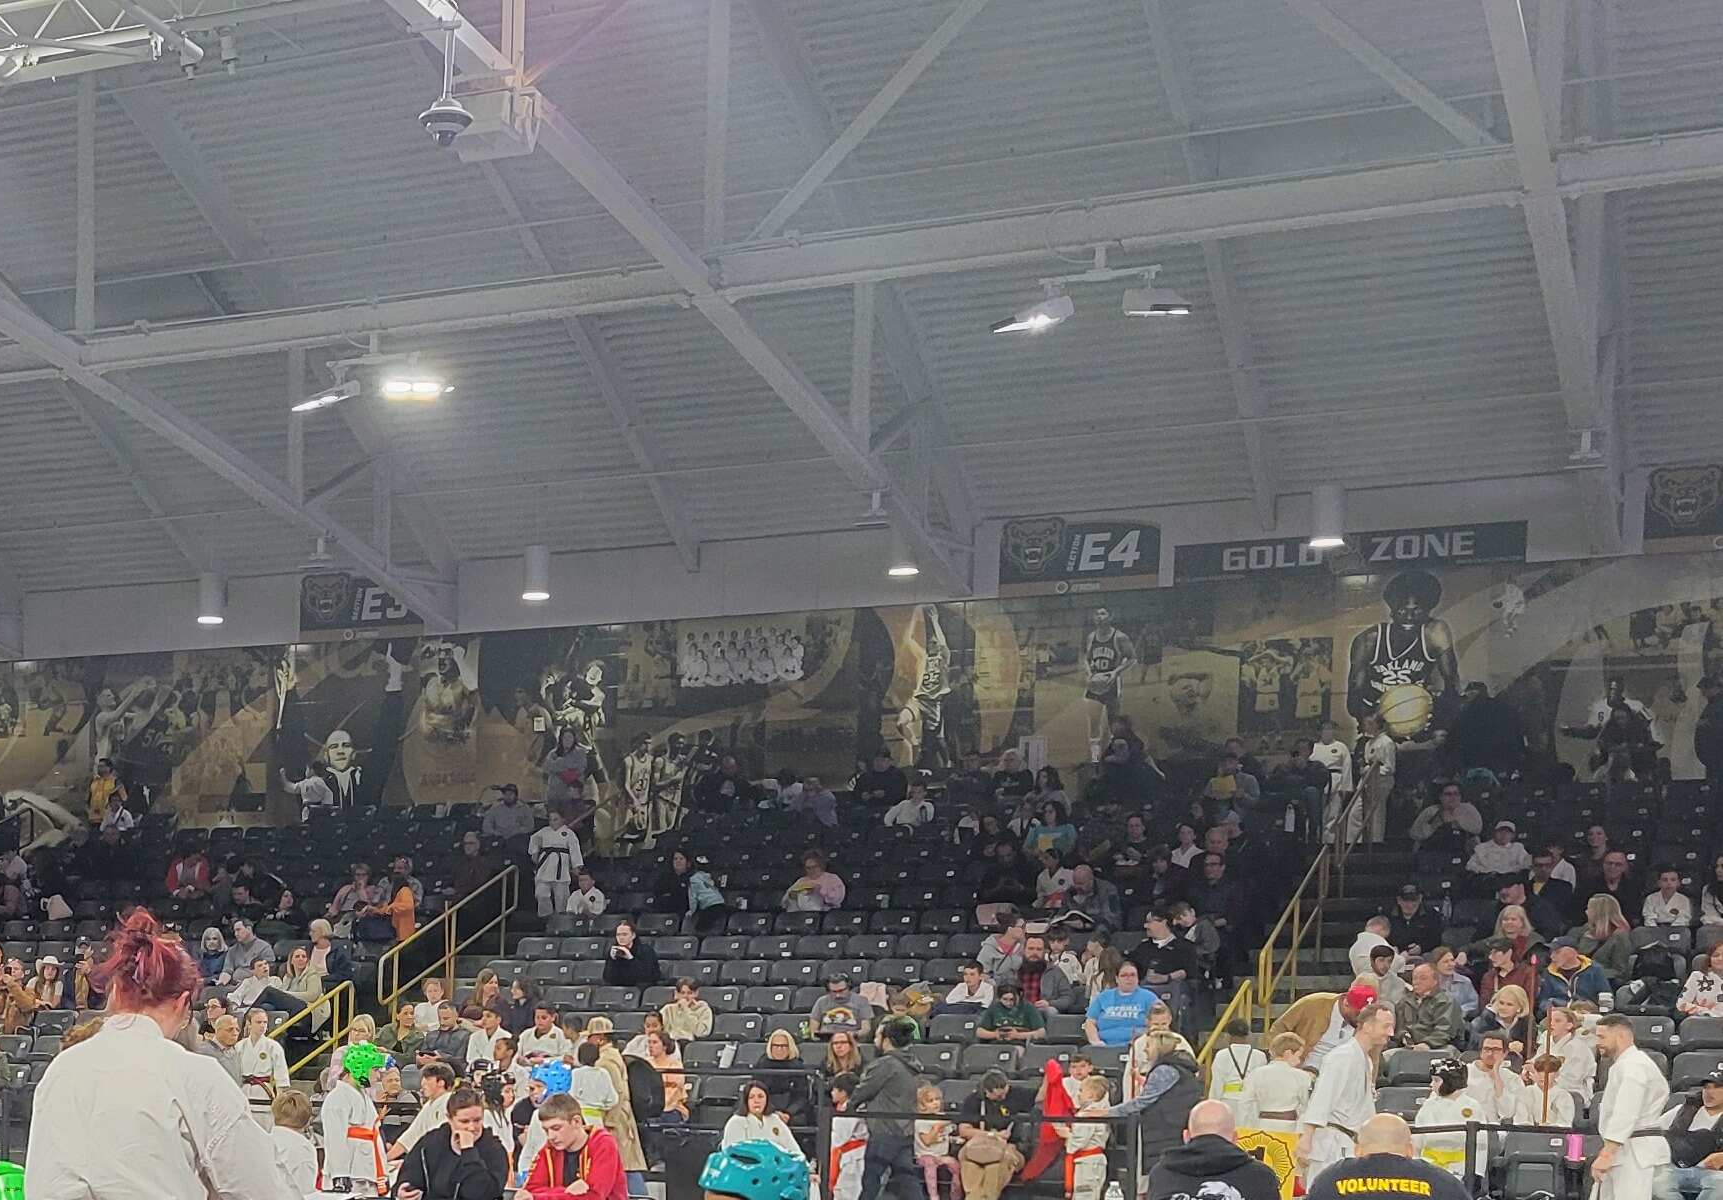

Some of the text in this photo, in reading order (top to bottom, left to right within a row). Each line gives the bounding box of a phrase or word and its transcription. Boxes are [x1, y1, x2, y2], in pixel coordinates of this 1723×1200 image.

[1079, 529, 1141, 572] E4
[1222, 531, 1475, 572] GOLD ZONE
[1382, 669, 1412, 685] 25
[1335, 1177, 1432, 1197] VOLUNTEER
